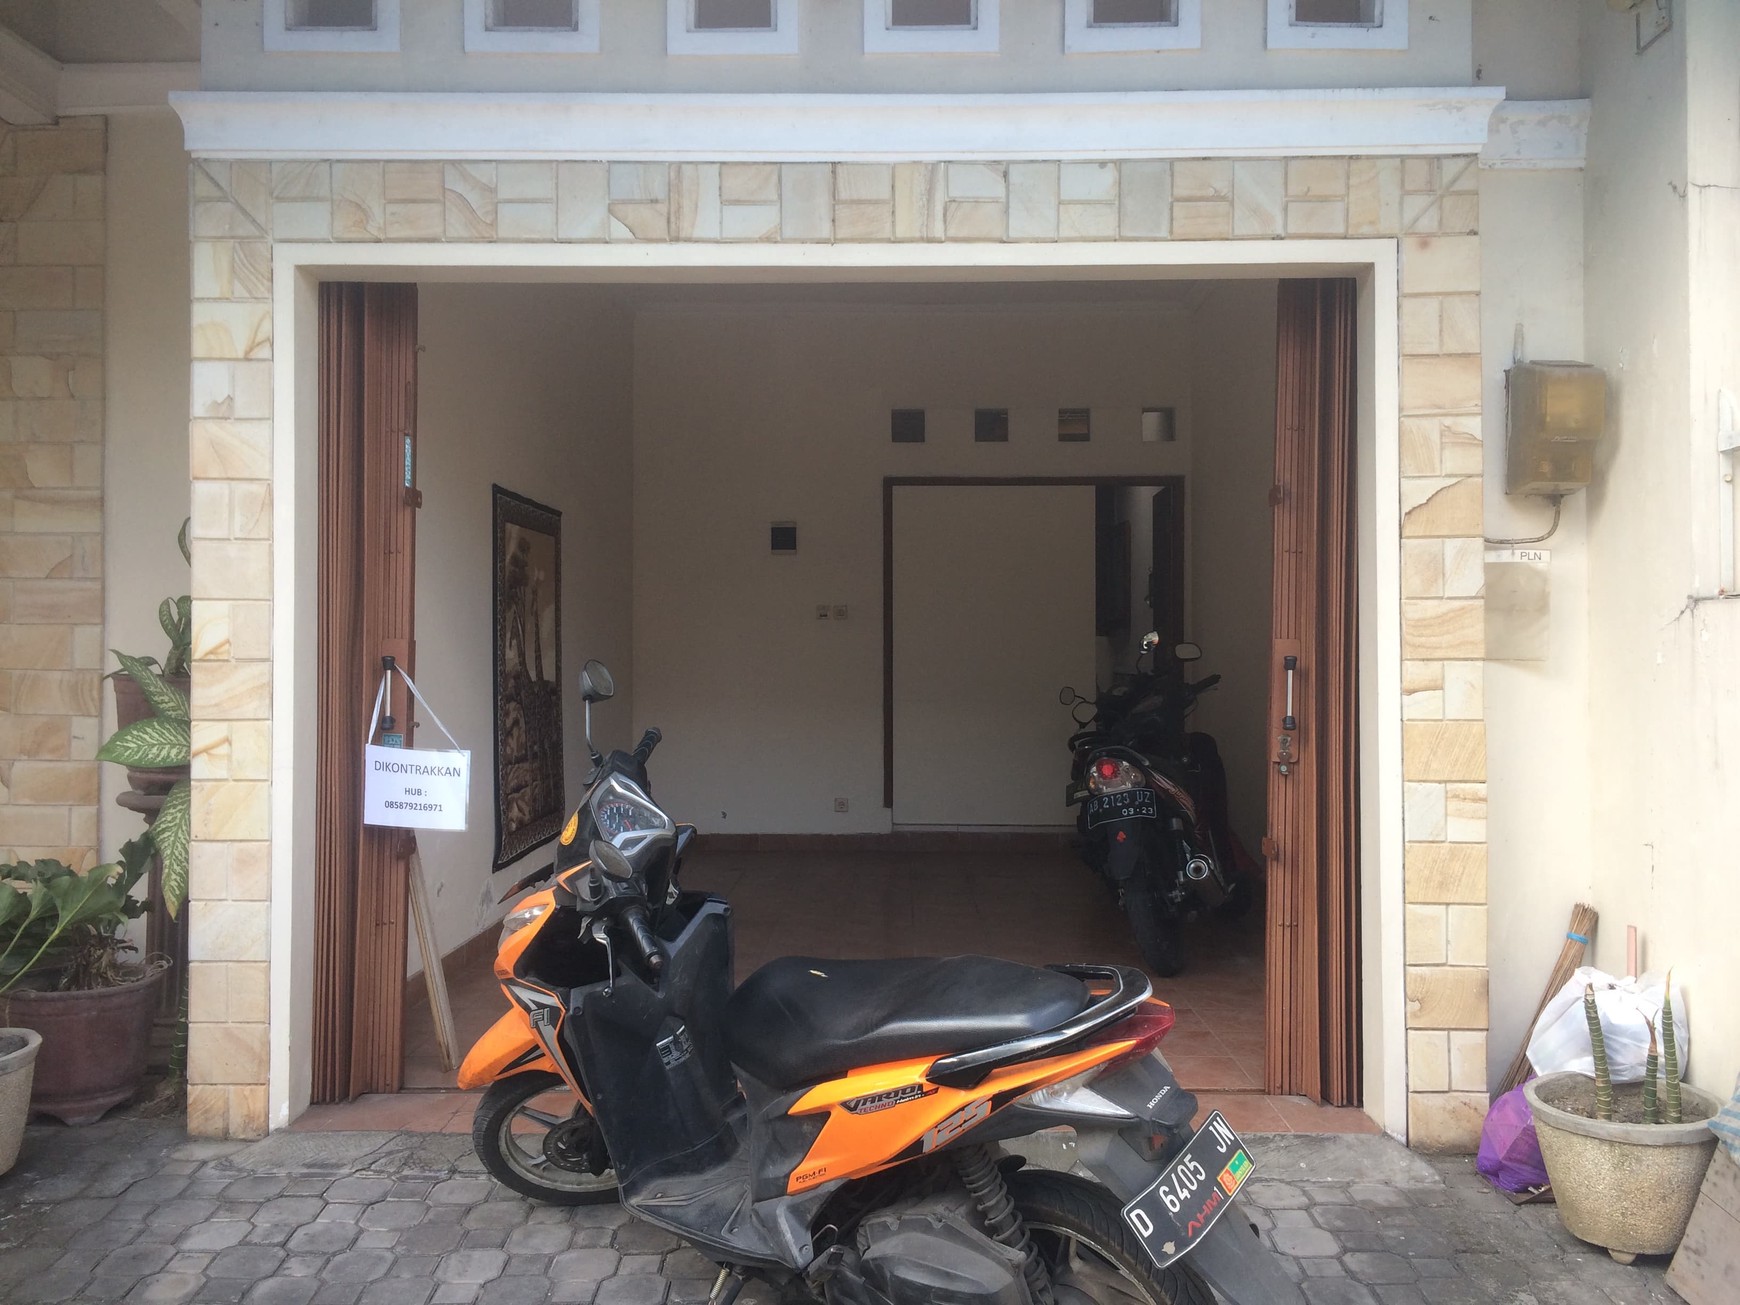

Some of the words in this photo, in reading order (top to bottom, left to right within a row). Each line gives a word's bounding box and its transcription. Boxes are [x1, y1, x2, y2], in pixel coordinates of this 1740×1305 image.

[1520, 551, 1542, 561] PLN
[374, 760, 461, 777] DIKONTRAKKAN
[404, 787, 423, 797] HUB
[1103, 793, 1130, 808] 2123
[1136, 791, 1151, 803] UZ
[384, 800, 443, 812] 085879216971
[1147, 1086, 1171, 1109] HONDA
[859, 1101, 895, 1114] TECHNO
[920, 1096, 993, 1153] 125
[1129, 1208, 1154, 1238] D
[1158, 1153, 1206, 1213] 6405
[1208, 1116, 1235, 1153] JN
